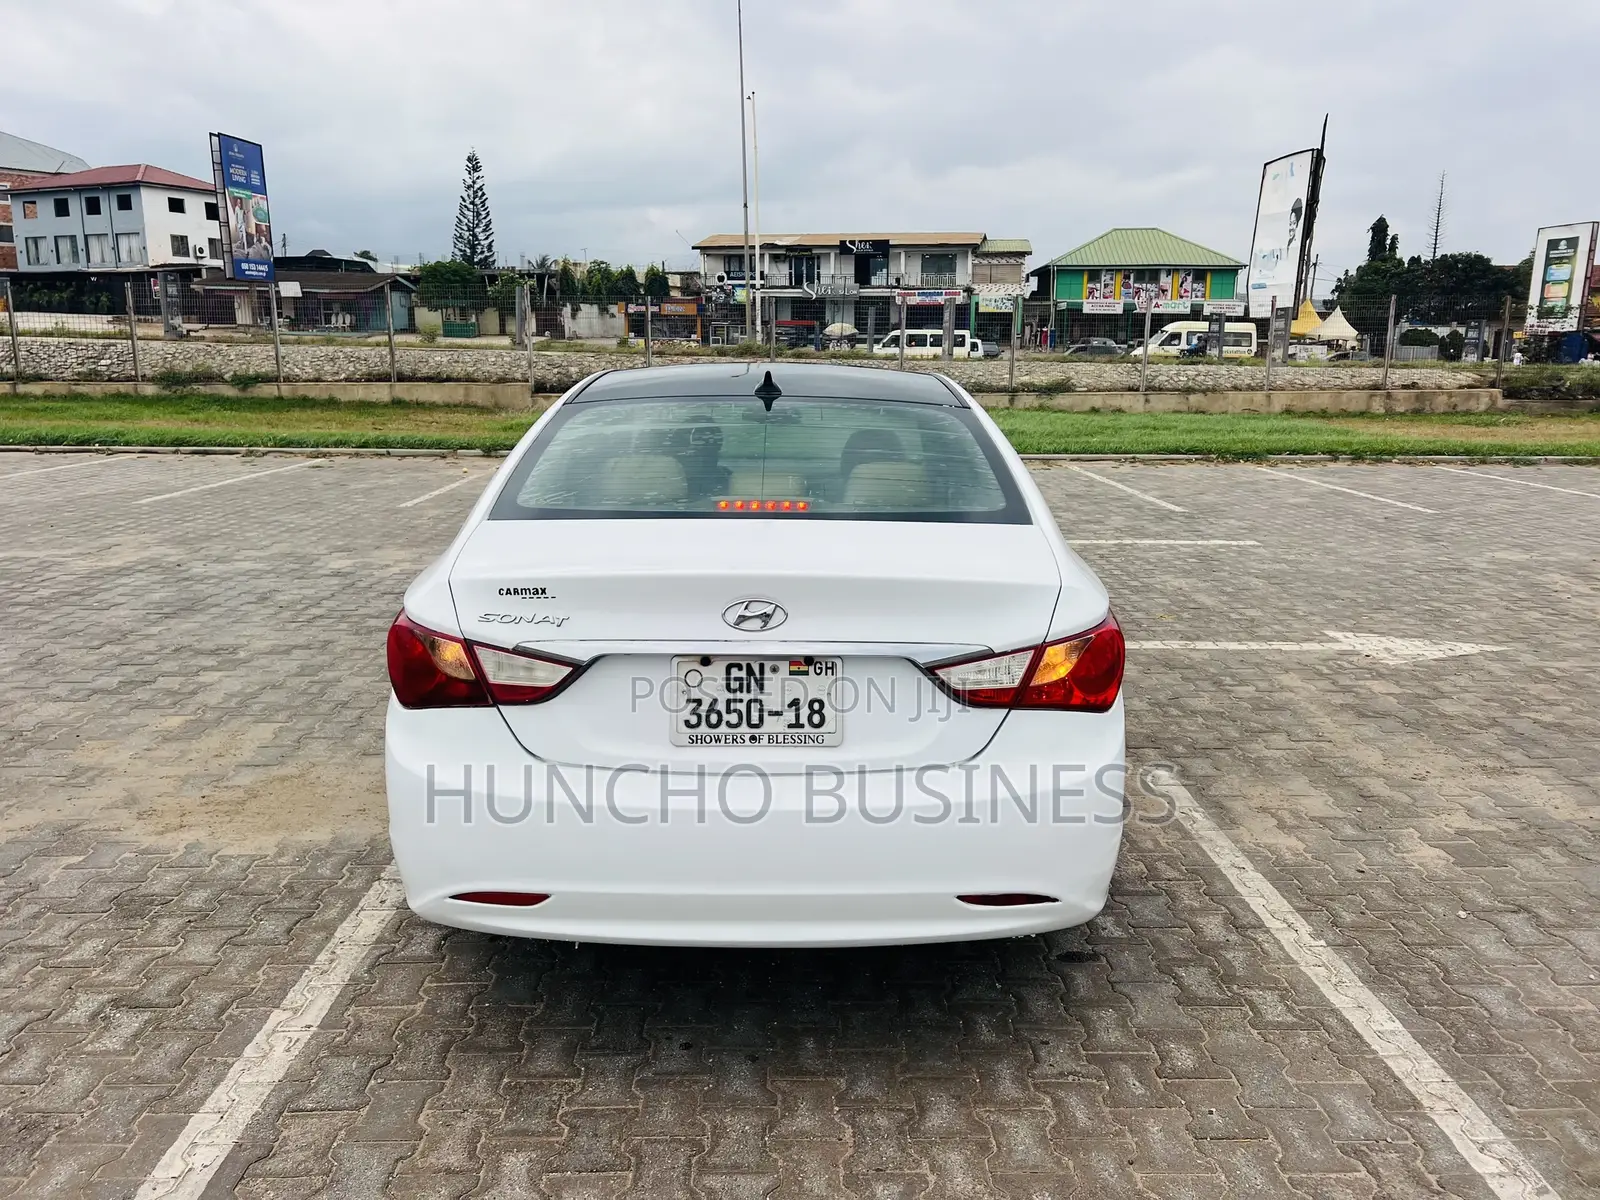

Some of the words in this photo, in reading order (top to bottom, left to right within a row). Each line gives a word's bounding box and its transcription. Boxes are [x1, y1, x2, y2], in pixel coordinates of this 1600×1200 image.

[725, 662, 765, 694] GN
[813, 661, 835, 676] GH
[684, 697, 826, 729] 3650-18
[688, 734, 746, 745] SHOWERS
[749, 734, 765, 744] OF
[767, 734, 825, 745] BLESSING
